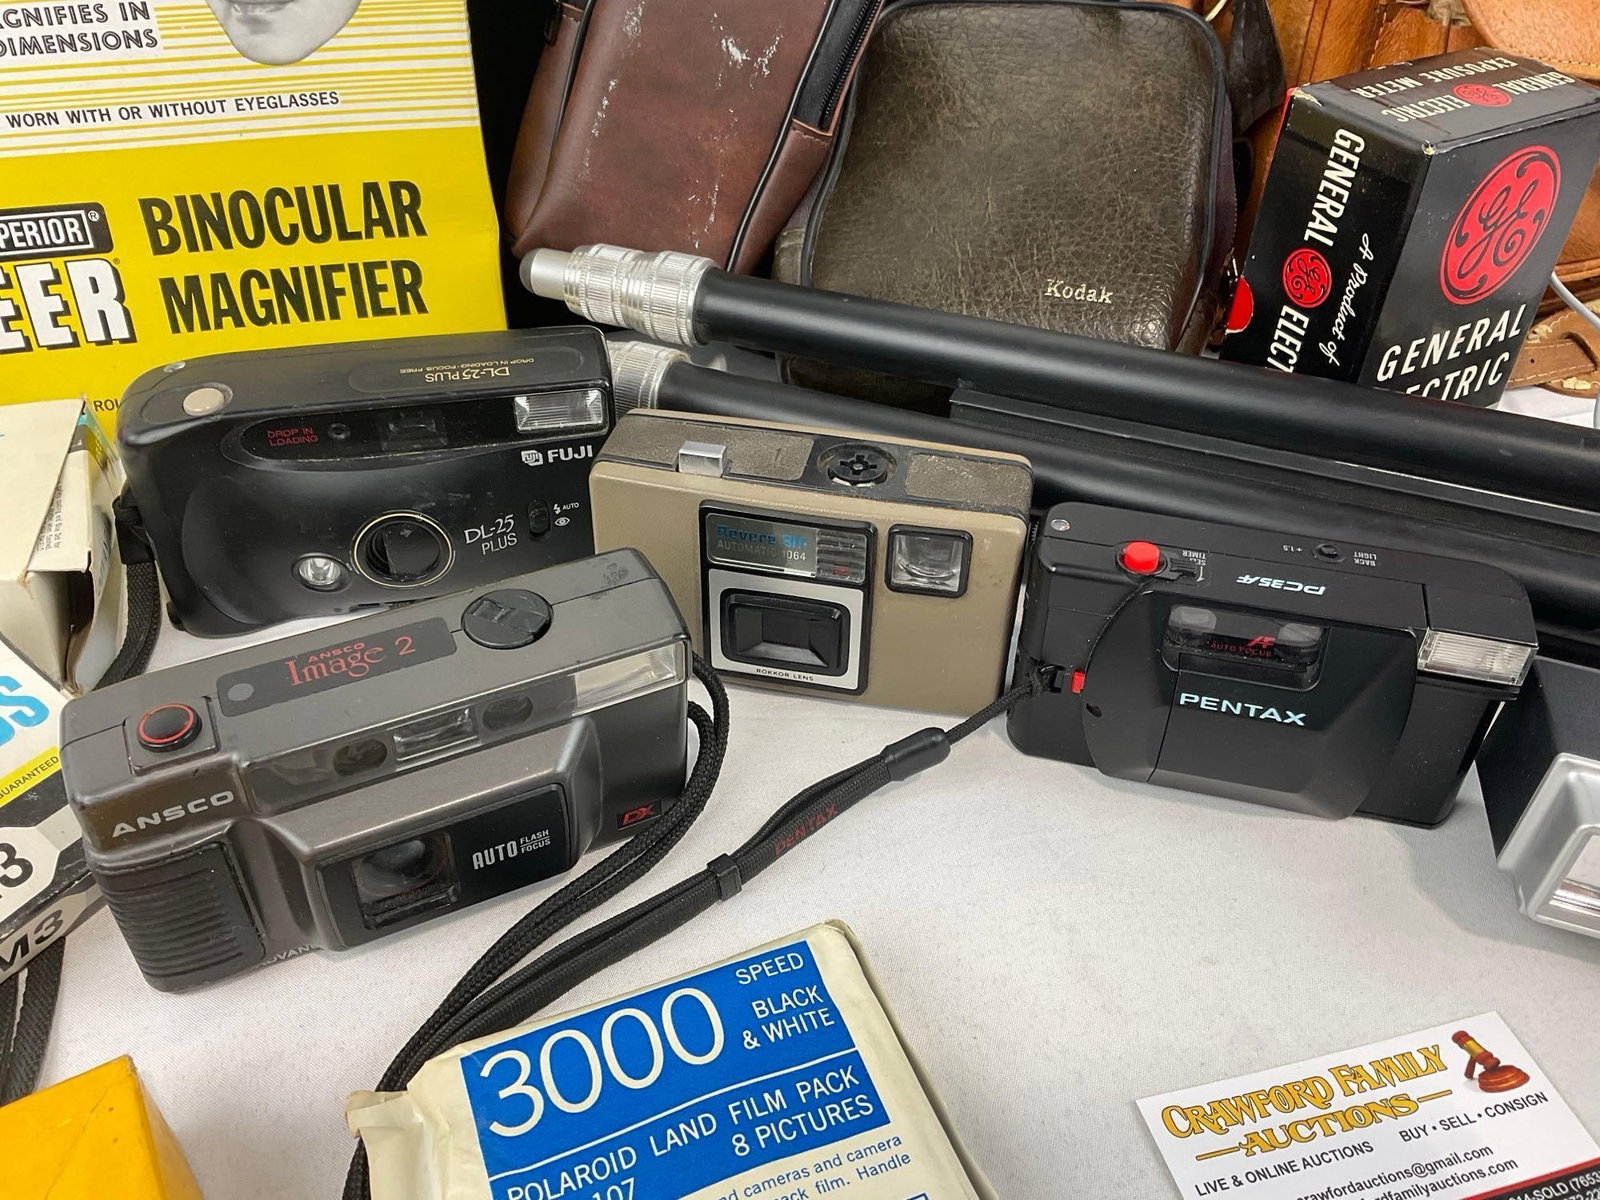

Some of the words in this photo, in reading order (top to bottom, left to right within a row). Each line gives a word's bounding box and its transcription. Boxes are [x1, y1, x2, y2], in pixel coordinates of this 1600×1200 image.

[0, 3, 109, 29] GNIFIES
[119, 1, 150, 21] IN
[1419, 57, 1519, 83] EXPOSURE
[1492, 71, 1576, 96] GENERAL
[1350, 76, 1424, 99] METER
[5, 112, 60, 128] WORN
[66, 108, 112, 125] WITH
[118, 106, 142, 121] OR
[148, 99, 226, 119] WITHOUT
[234, 91, 339, 112] EYEGLASSES
[1381, 94, 1472, 122] ELECTRIC
[1303, 128, 1366, 247] GENERAL
[138, 180, 428, 256] BINOCULAR
[1359, 233, 1374, 261] A
[158, 259, 429, 335] MAGNIFIER
[1044, 279, 1114, 304] Kodak
[1332, 262, 1369, 341] Product
[1318, 341, 1340, 366] of
[1376, 303, 1527, 382] GENERAL
[462, 366, 511, 381] DL-25
[510, 357, 535, 365] DROP
[425, 371, 460, 383] PLUS
[1405, 351, 1510, 401] CTRIC
[267, 428, 299, 439] DROP
[303, 427, 314, 435] IN
[269, 435, 319, 447] LOADING
[547, 444, 593, 463] FUJI
[562, 502, 580, 511] AUTO
[463, 513, 515, 544] DL-25
[481, 532, 518, 555] PLUS
[716, 539, 777, 557] AUTOMATIC
[1182, 550, 1207, 559] TIMER
[1354, 551, 1377, 560] LIGHT
[1354, 558, 1376, 566] BACK
[284, 647, 384, 686] Image
[394, 636, 416, 655] 2
[308, 642, 365, 663] ANSCO
[756, 668, 789, 678] ROKKOR
[793, 674, 814, 682] LENS
[1180, 692, 1308, 726] PENTAX
[112, 790, 234, 839] ANSCO
[622, 803, 655, 827] DX
[520, 829, 550, 844] FLASH
[521, 838, 551, 854] FOCUS
[0, 842, 33, 894] 3
[472, 840, 518, 870] AUTO
[735, 952, 804, 985] SPEED
[752, 985, 824, 1019] BLACK
[742, 1029, 760, 1050] &
[761, 1007, 835, 1043] WHITE
[479, 987, 725, 1138] 3000
[1161, 1075, 1335, 1138] CRAWFORD
[1328, 1044, 1448, 1097] FAMILY
[731, 1133, 751, 1157] 8
[754, 1094, 874, 1149] PICTURES
[1238, 1092, 1420, 1157] AUCTIONS
[1399, 1124, 1429, 1142] BUY
[1439, 1113, 1477, 1131] SELL
[1484, 1091, 1549, 1118] CONSIGN
[507, 1146, 637, 1200] POLAROID
[649, 1112, 718, 1157] LAND
[728, 1088, 787, 1125] FILM
[795, 1064, 860, 1103] PACK
[743, 1167, 811, 1197] cameras
[814, 1152, 843, 1174] and
[846, 1135, 903, 1162] camera
[814, 1175, 851, 1195] film.
[856, 1151, 912, 1181] Handle
[1195, 1178, 1230, 1197] LIVE
[1231, 1174, 1244, 1188] &
[1245, 1160, 1300, 1184] ONLINE
[1301, 1141, 1374, 1170] AUCTIONS
